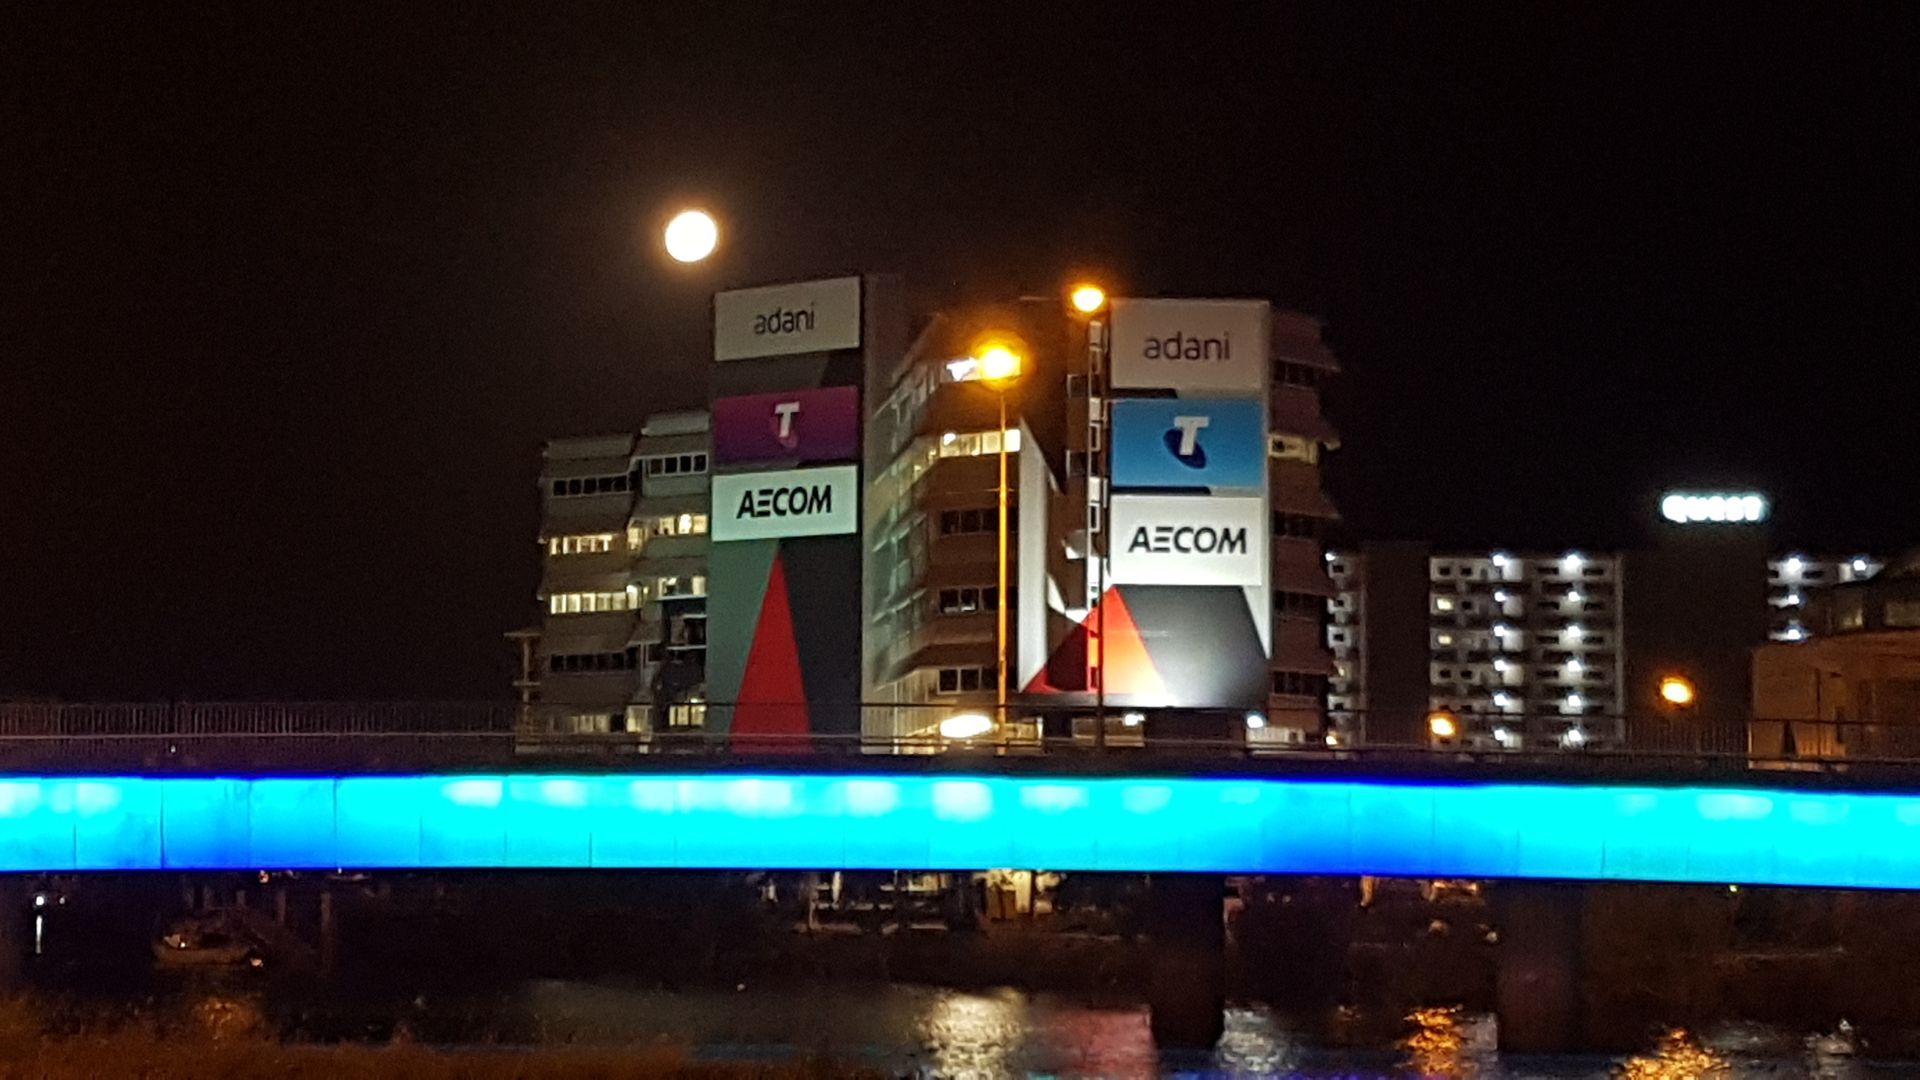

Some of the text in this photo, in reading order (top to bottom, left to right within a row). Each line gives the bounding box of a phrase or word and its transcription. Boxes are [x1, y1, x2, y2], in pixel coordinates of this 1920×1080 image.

[754, 303, 814, 335] adani
[1143, 331, 1231, 361] adani
[774, 401, 800, 437] T
[1174, 416, 1209, 455] T
[736, 485, 832, 519] AECOM
[1128, 526, 1247, 554] AECOM
